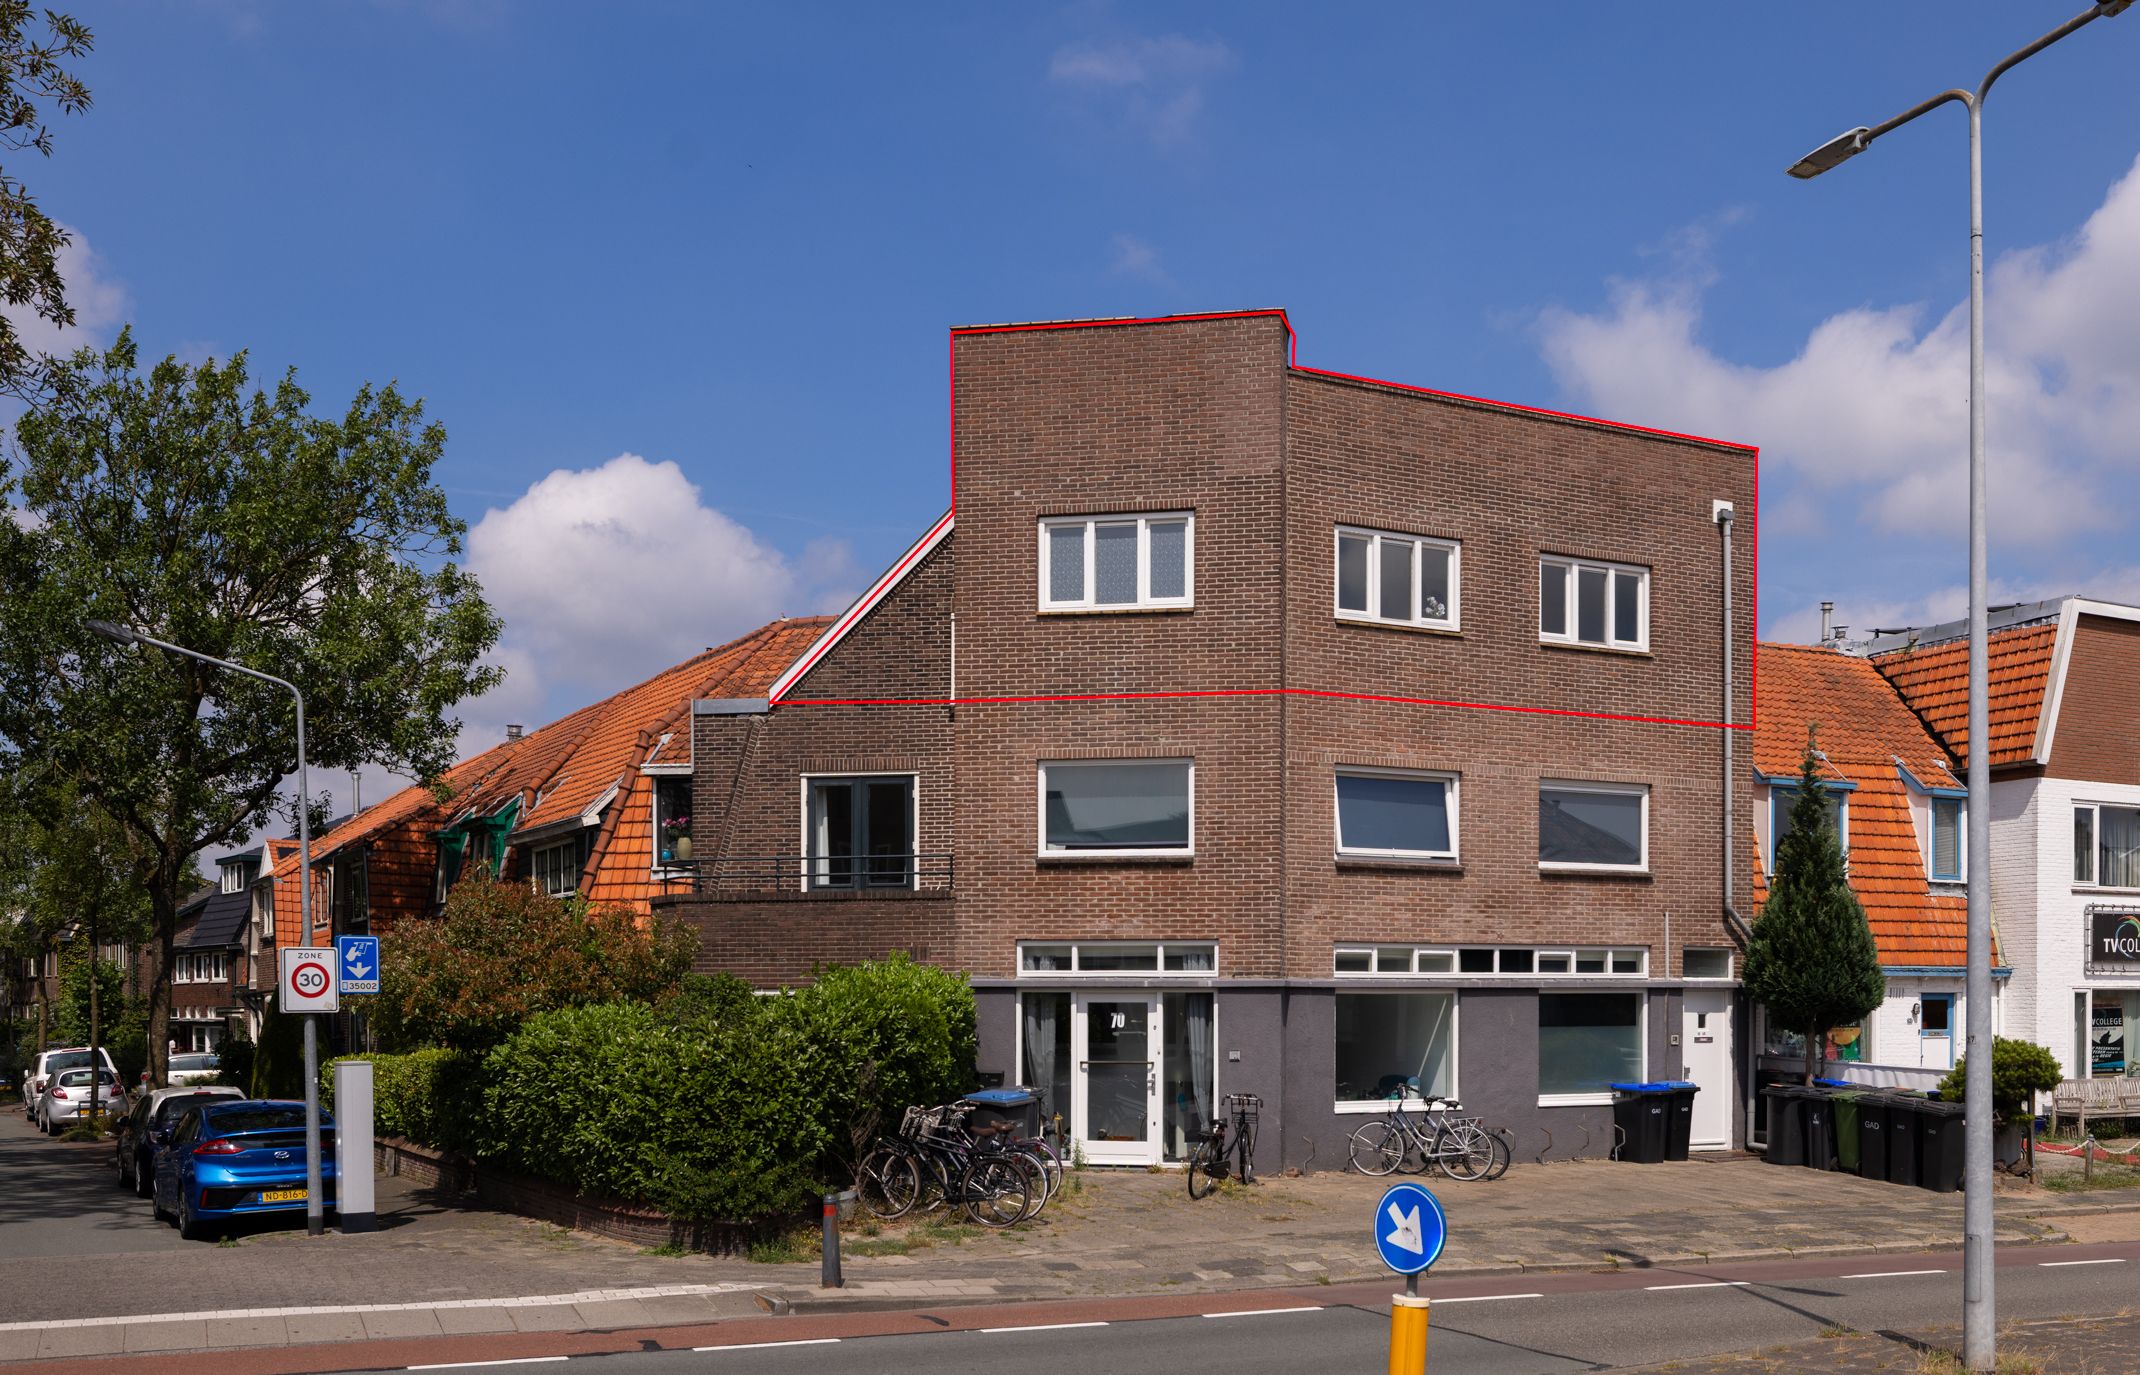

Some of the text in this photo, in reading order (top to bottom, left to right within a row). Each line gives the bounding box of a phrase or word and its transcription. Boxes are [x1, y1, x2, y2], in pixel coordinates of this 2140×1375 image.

[299, 973, 323, 987] 30
[349, 982, 377, 990] 35002
[1110, 1012, 1125, 1028] 70
[1864, 1120, 1880, 1130] GAD
[265, 1189, 308, 1201] ND-816-D
